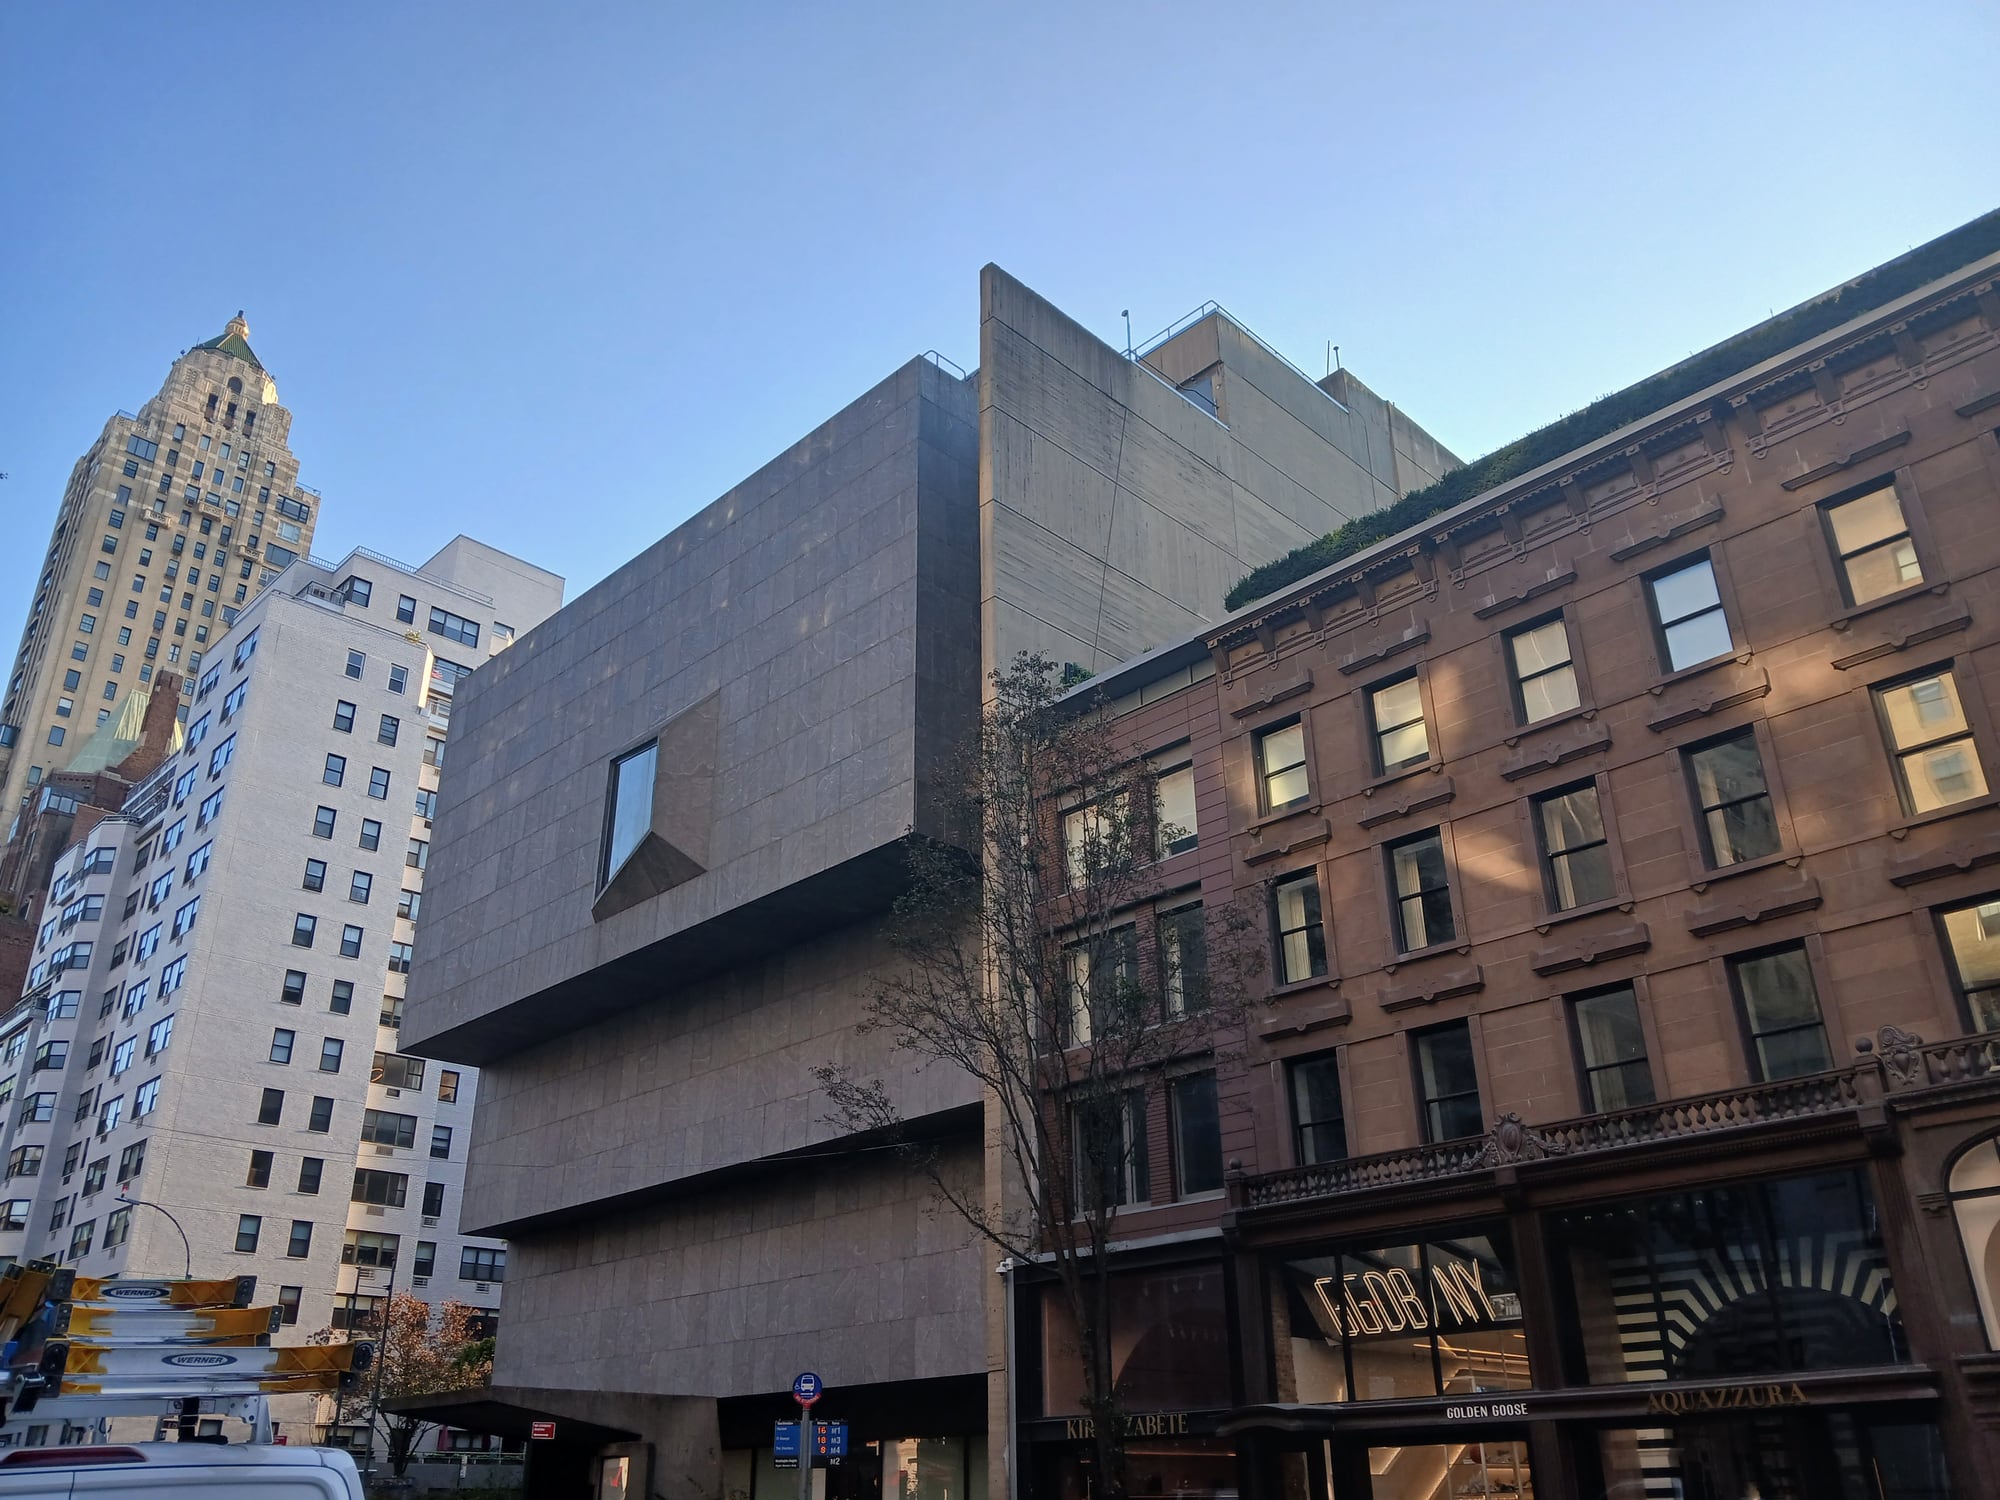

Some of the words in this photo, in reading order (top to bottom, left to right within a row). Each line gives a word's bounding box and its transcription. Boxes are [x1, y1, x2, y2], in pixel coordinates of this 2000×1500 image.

[115, 1287, 158, 1297] WERNER
[177, 1356, 224, 1364] WERNER
[1647, 1382, 1809, 1416] AQUAZZURA
[1446, 1405, 1488, 1419] GOLDEN
[1492, 1403, 1529, 1417] GOOSE
[831, 1436, 841, 1444] M3
[830, 1446, 841, 1454] M4
[830, 1457, 841, 1465] M2
